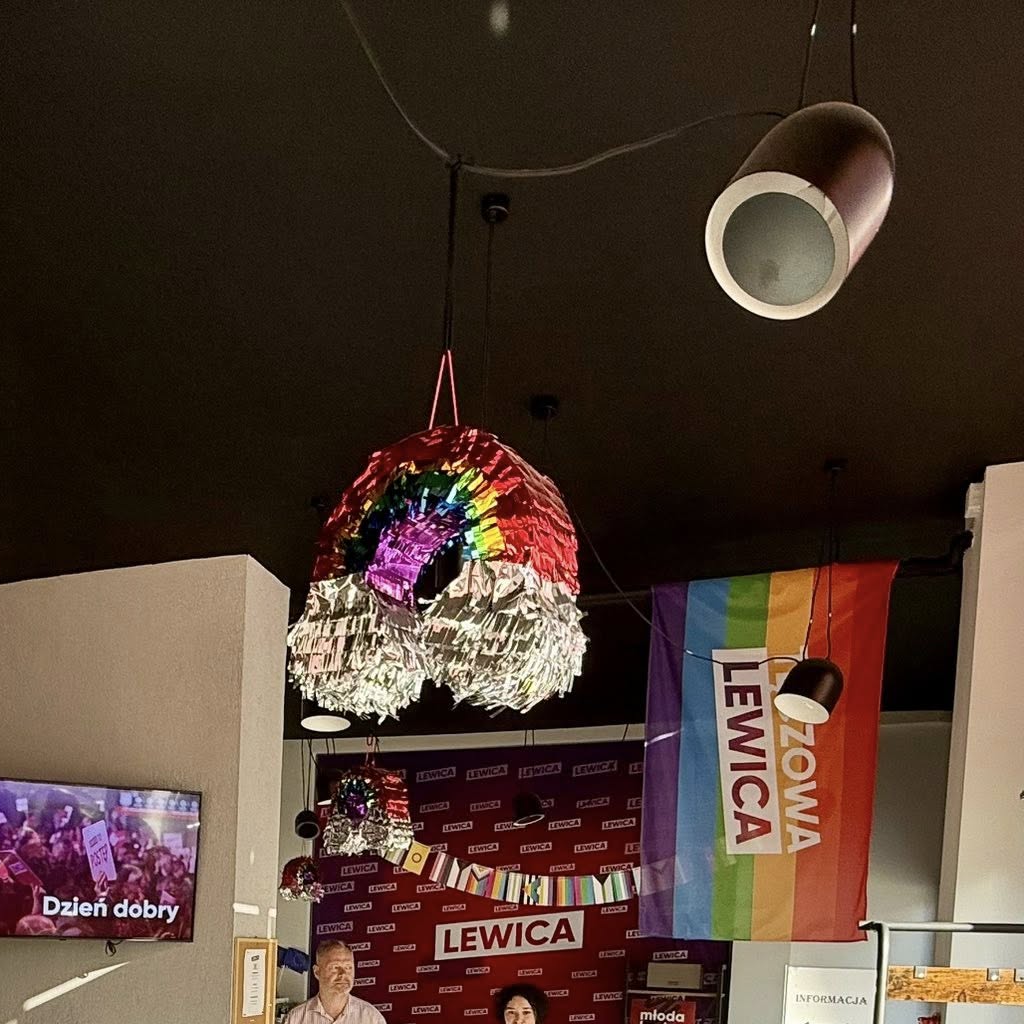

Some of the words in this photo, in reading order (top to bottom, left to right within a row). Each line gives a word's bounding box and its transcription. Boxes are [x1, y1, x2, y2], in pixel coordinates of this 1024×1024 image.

[723, 662, 772, 845] LEWICA
[418, 768, 455, 781] LEWICA
[468, 766, 506, 779] LEWICA
[521, 764, 560, 777] LEWICA
[422, 803, 448, 812] LEWICA
[472, 801, 499, 811] LEWICA
[444, 822, 471, 831] LEWICA
[550, 820, 580, 829] LEWICA
[604, 819, 634, 829] LEWICA
[470, 844, 497, 853] LEWICA
[522, 844, 550, 852] LEWICA
[576, 842, 605, 851] LEWICA
[343, 864, 376, 874] LEWICA
[551, 864, 574, 872] LEWICA
[370, 884, 395, 892] LEWICA
[43, 895, 107, 917] Dzień
[114, 899, 179, 923] dobry
[346, 903, 370, 911] LEWICA
[394, 903, 419, 911] LEWICA
[318, 922, 351, 933] LEWICA
[444, 917, 576, 954] LEWICA
[655, 951, 686, 959] LEWICA
[795, 994, 867, 1005] INFORMACJA
